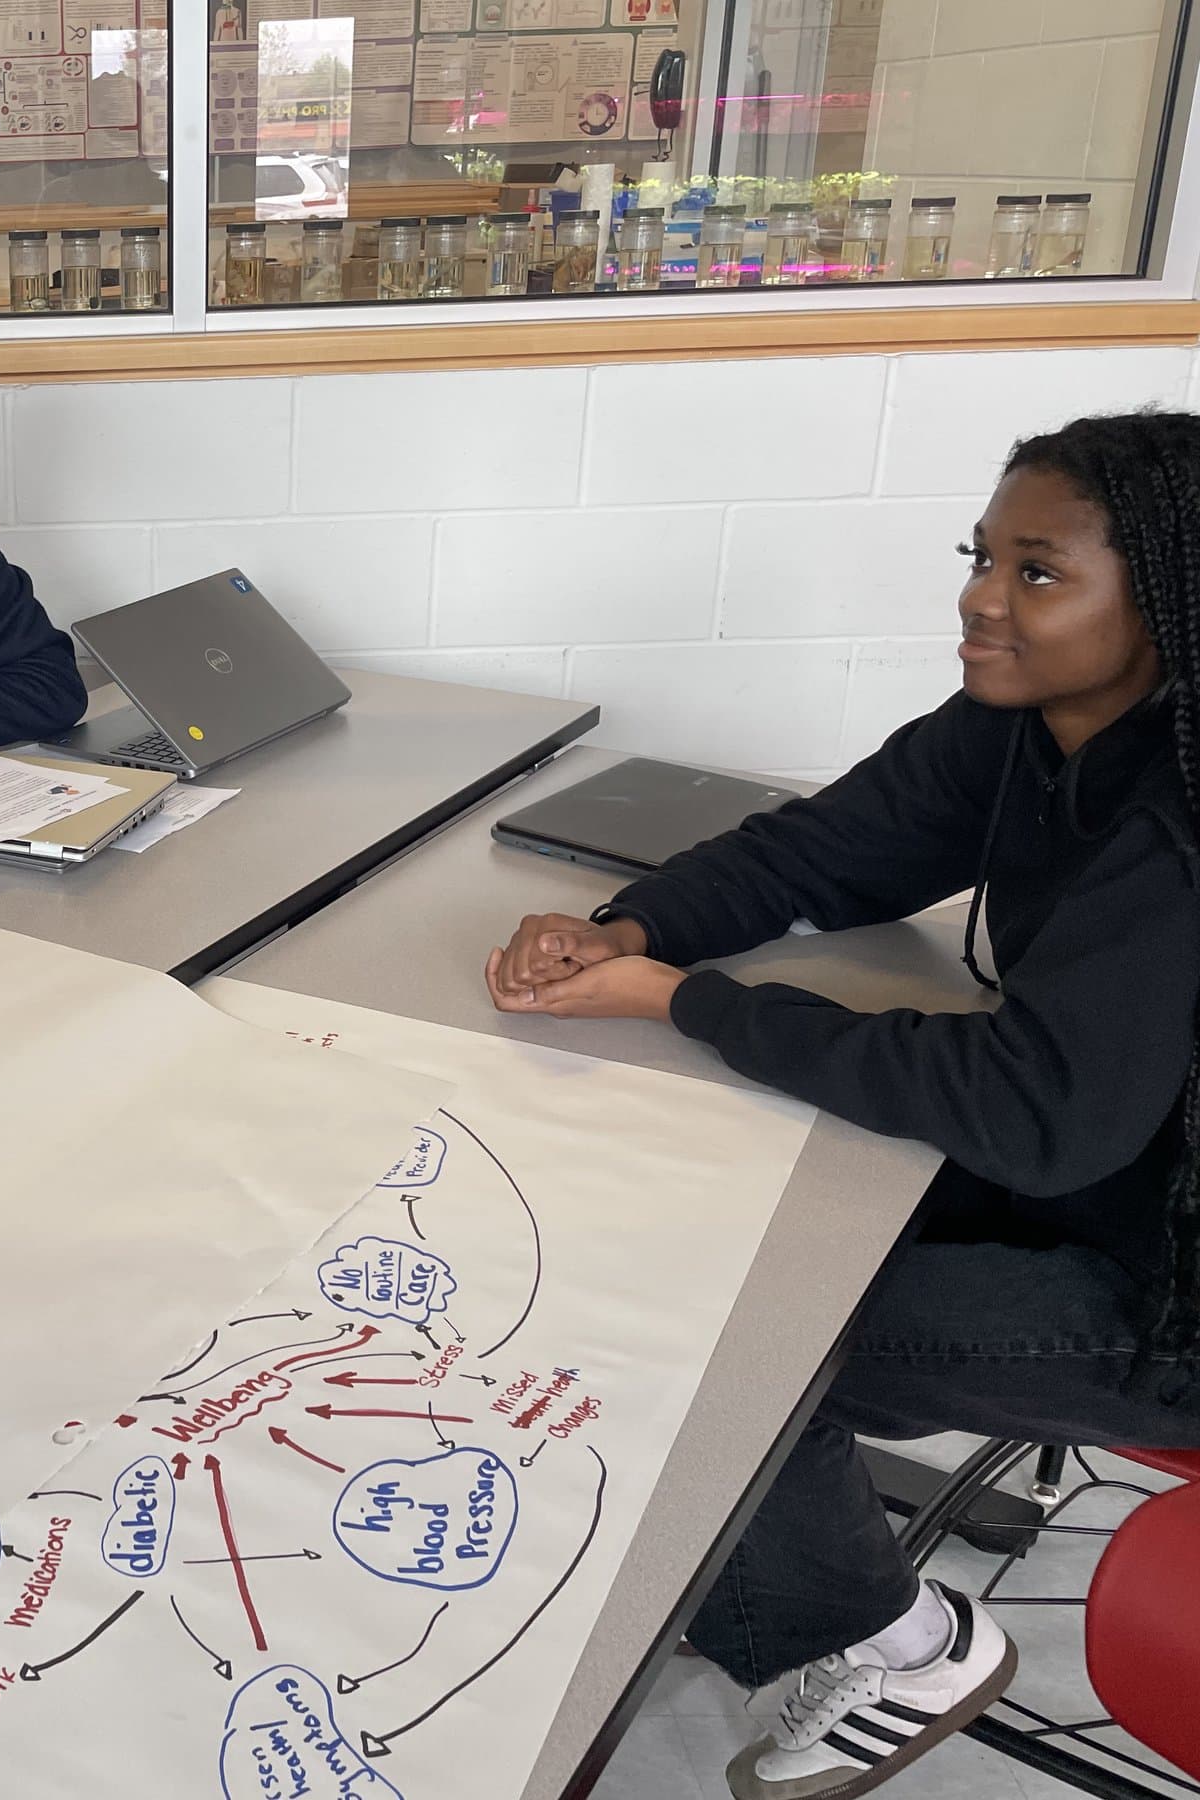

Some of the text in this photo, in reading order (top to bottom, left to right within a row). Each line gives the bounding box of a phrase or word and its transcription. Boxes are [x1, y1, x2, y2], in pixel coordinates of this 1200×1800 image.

[328, 1268, 363, 1290] No
[108, 1469, 160, 1572] diabetic
[340, 1481, 415, 1532] high
[397, 1503, 449, 1573] blood
